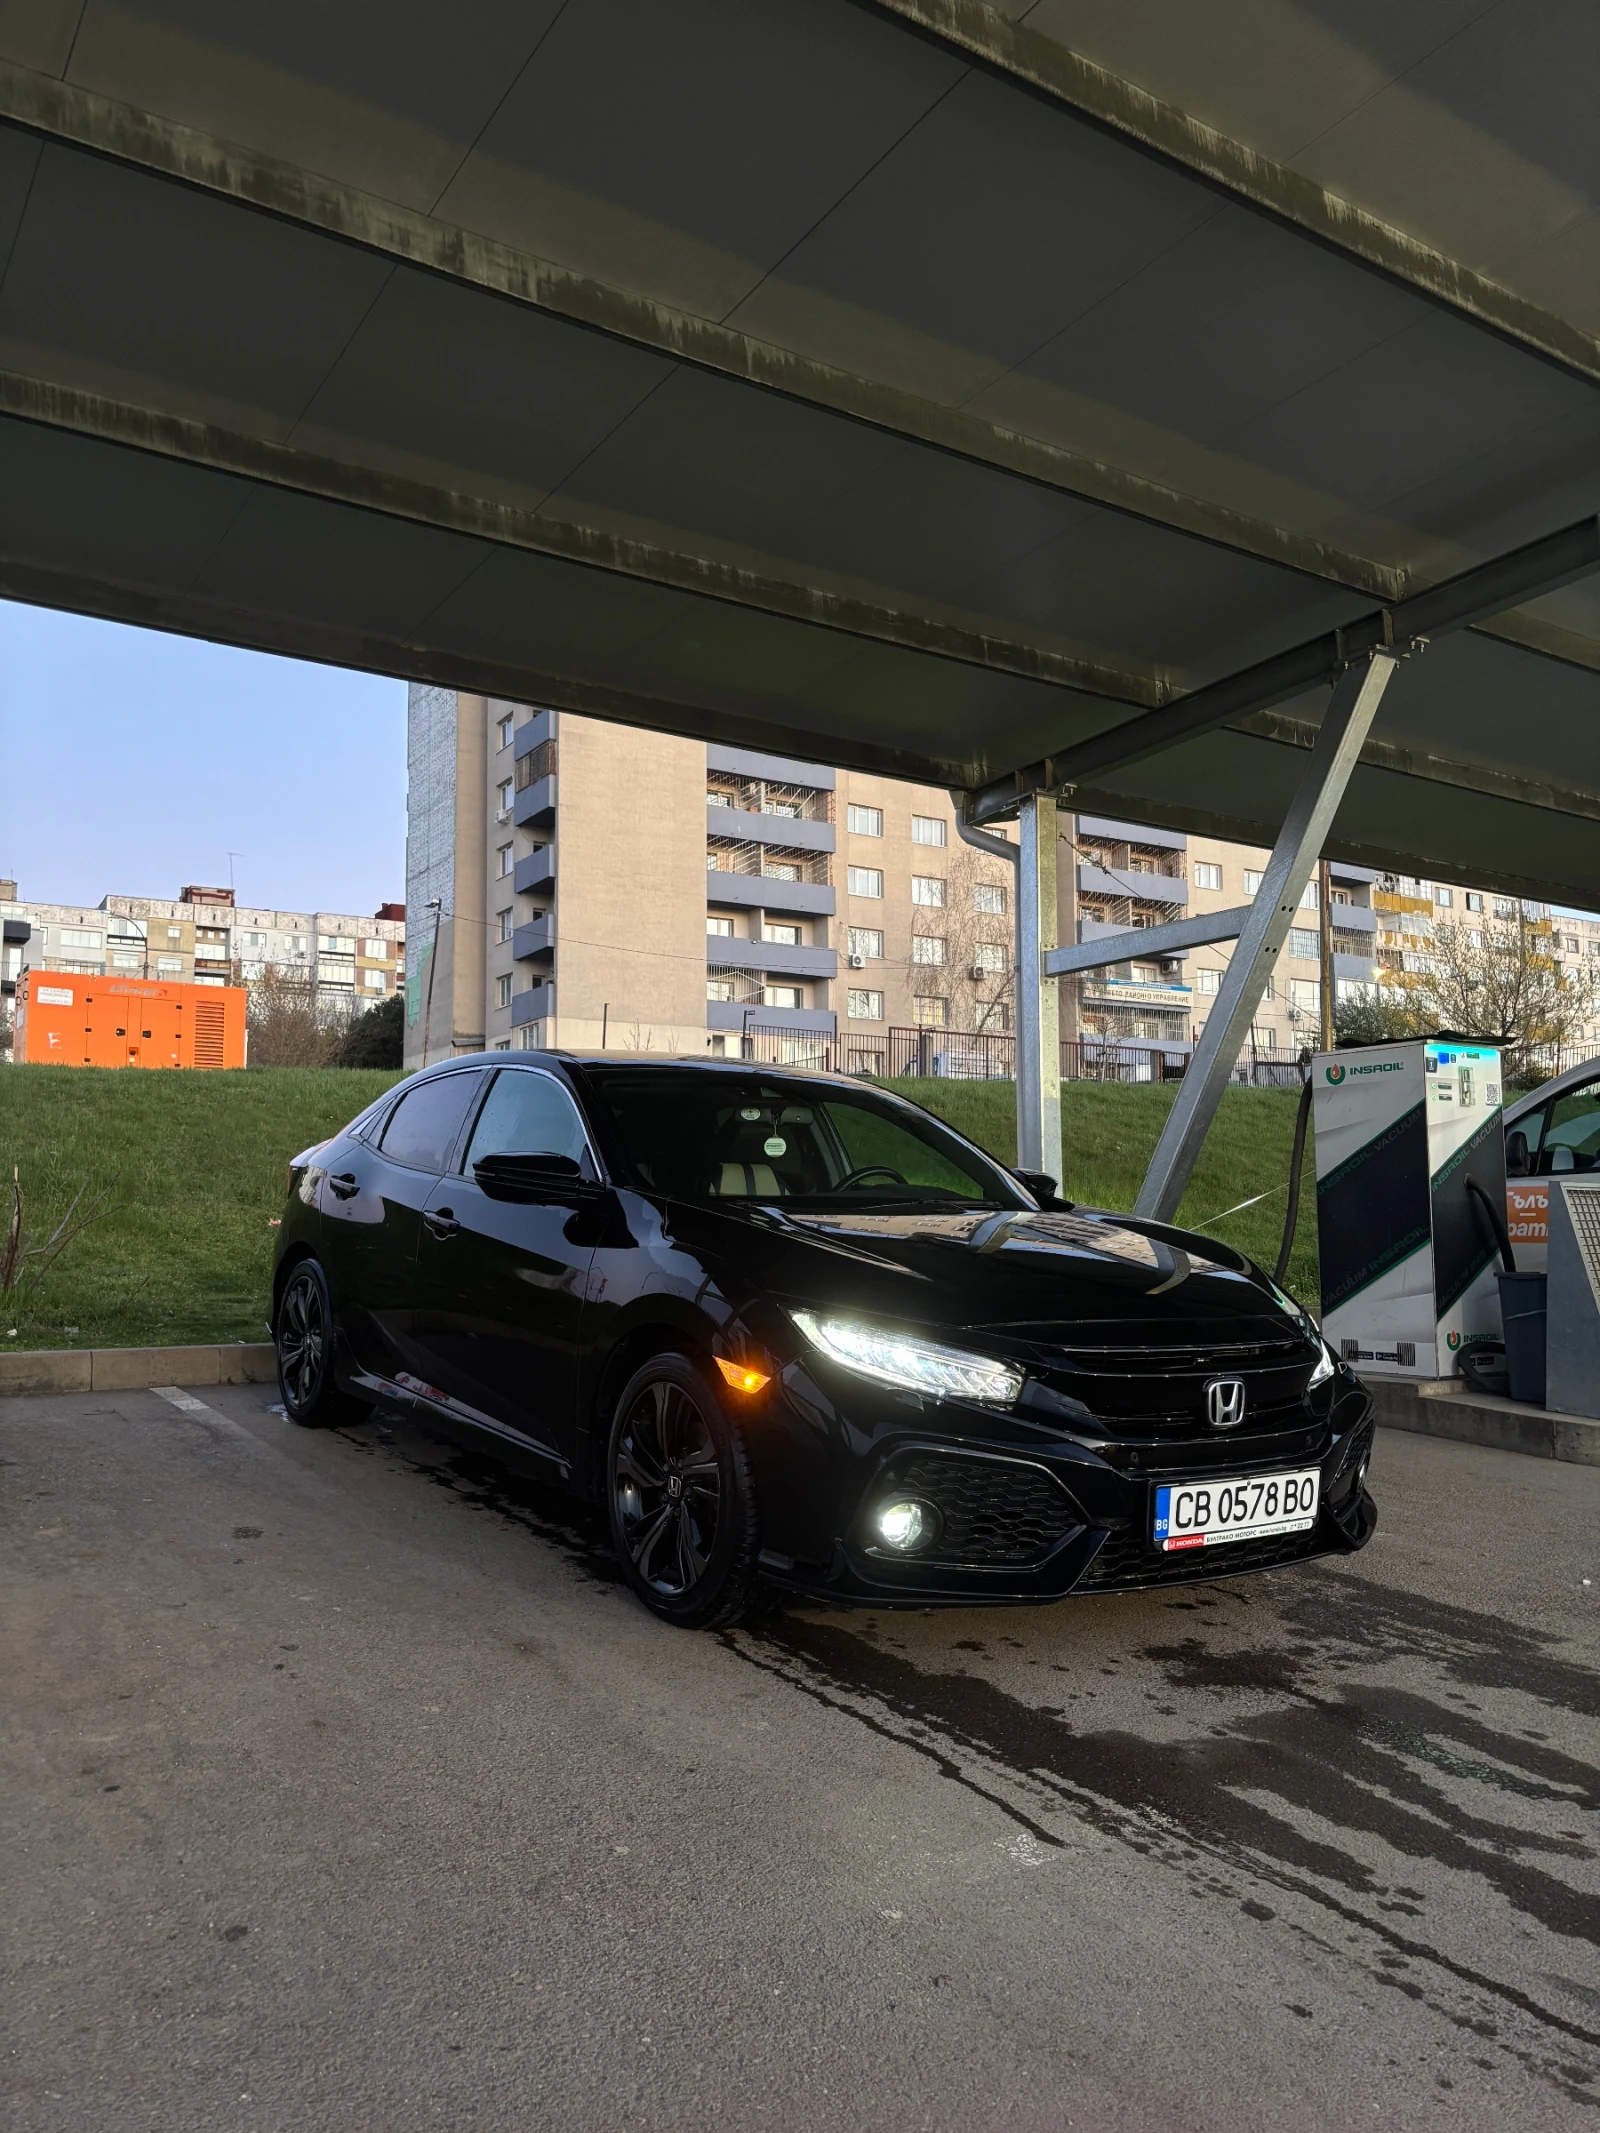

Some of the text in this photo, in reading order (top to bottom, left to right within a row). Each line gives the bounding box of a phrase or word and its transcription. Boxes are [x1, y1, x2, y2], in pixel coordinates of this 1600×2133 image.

[1350, 1062, 1404, 1076] INSAOIL
[1373, 1109, 1422, 1152] VACUUM
[1432, 1147, 1471, 1192] INSAOIL
[1322, 1267, 1368, 1307] VACUUM
[1175, 1477, 1315, 1529] CB 0578 BO
[1156, 1519, 1169, 1532] BG
[1234, 1529, 1257, 1539] МОТОРС
[1175, 1537, 1204, 1547] HONDA
